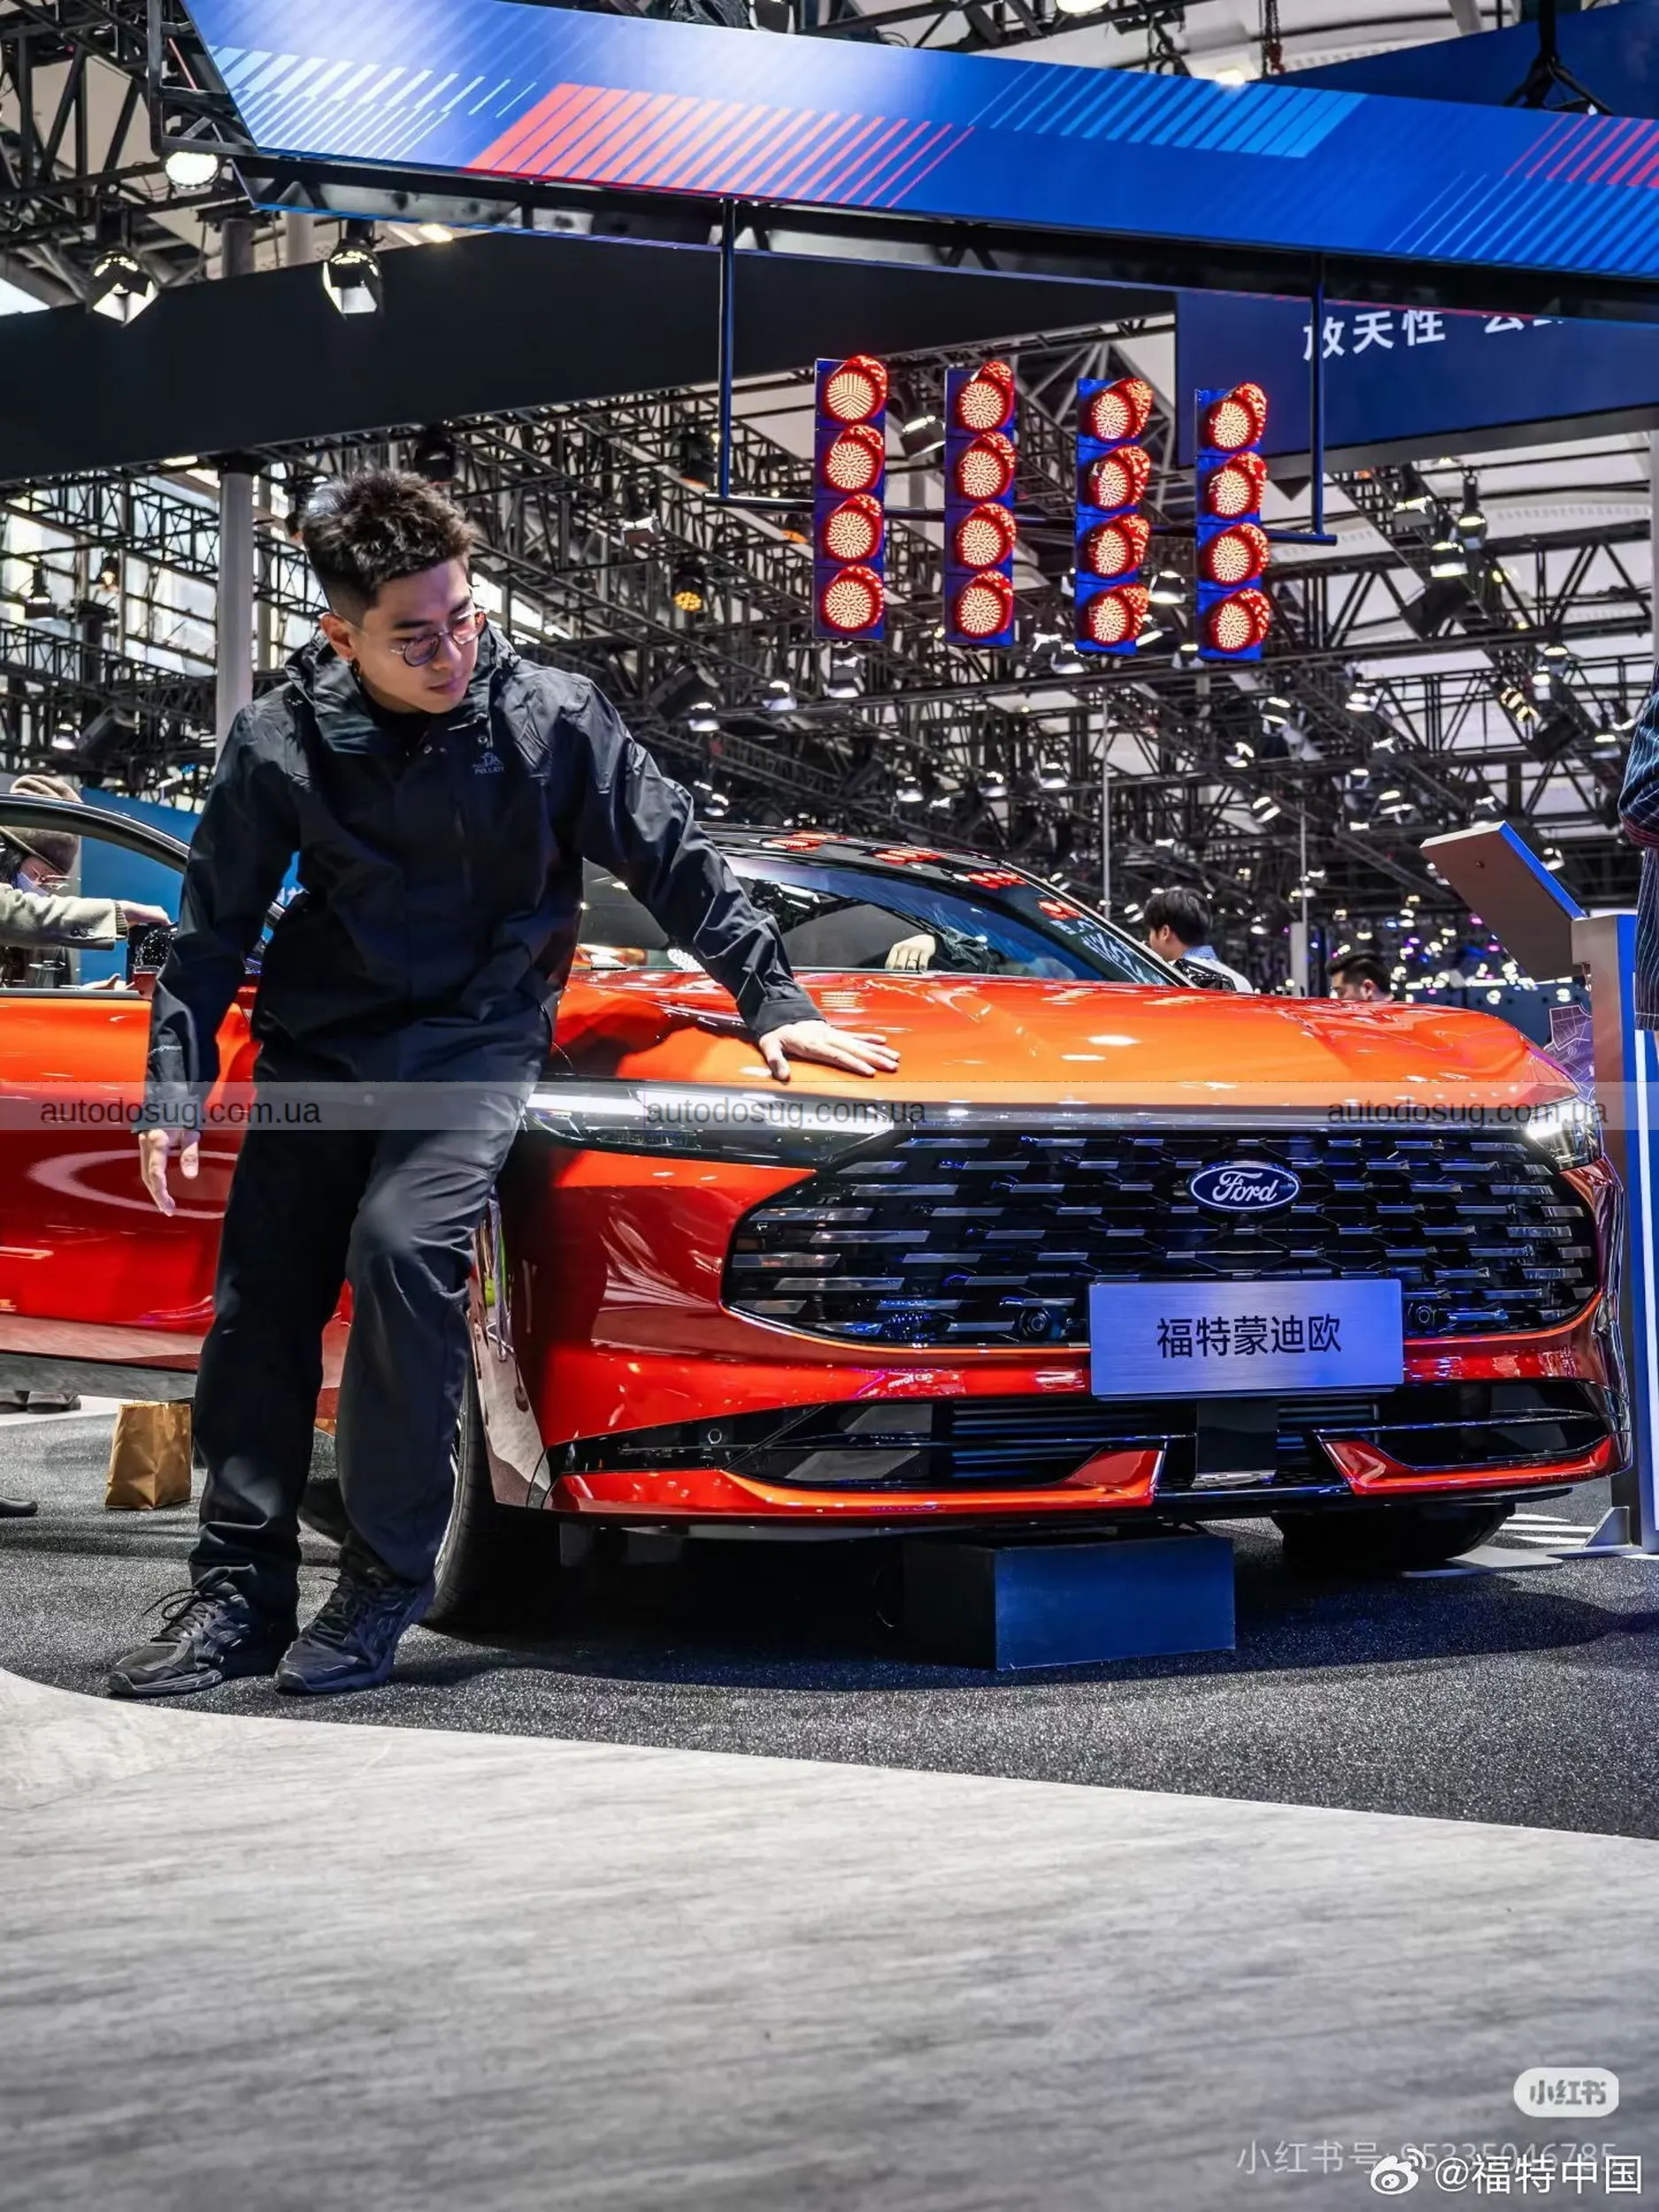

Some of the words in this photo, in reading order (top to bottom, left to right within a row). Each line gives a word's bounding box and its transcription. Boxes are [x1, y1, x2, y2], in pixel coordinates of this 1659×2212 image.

[1212, 1171, 1279, 1202] Ford
[1156, 1313, 1341, 1359] 福特蒙迪欧
